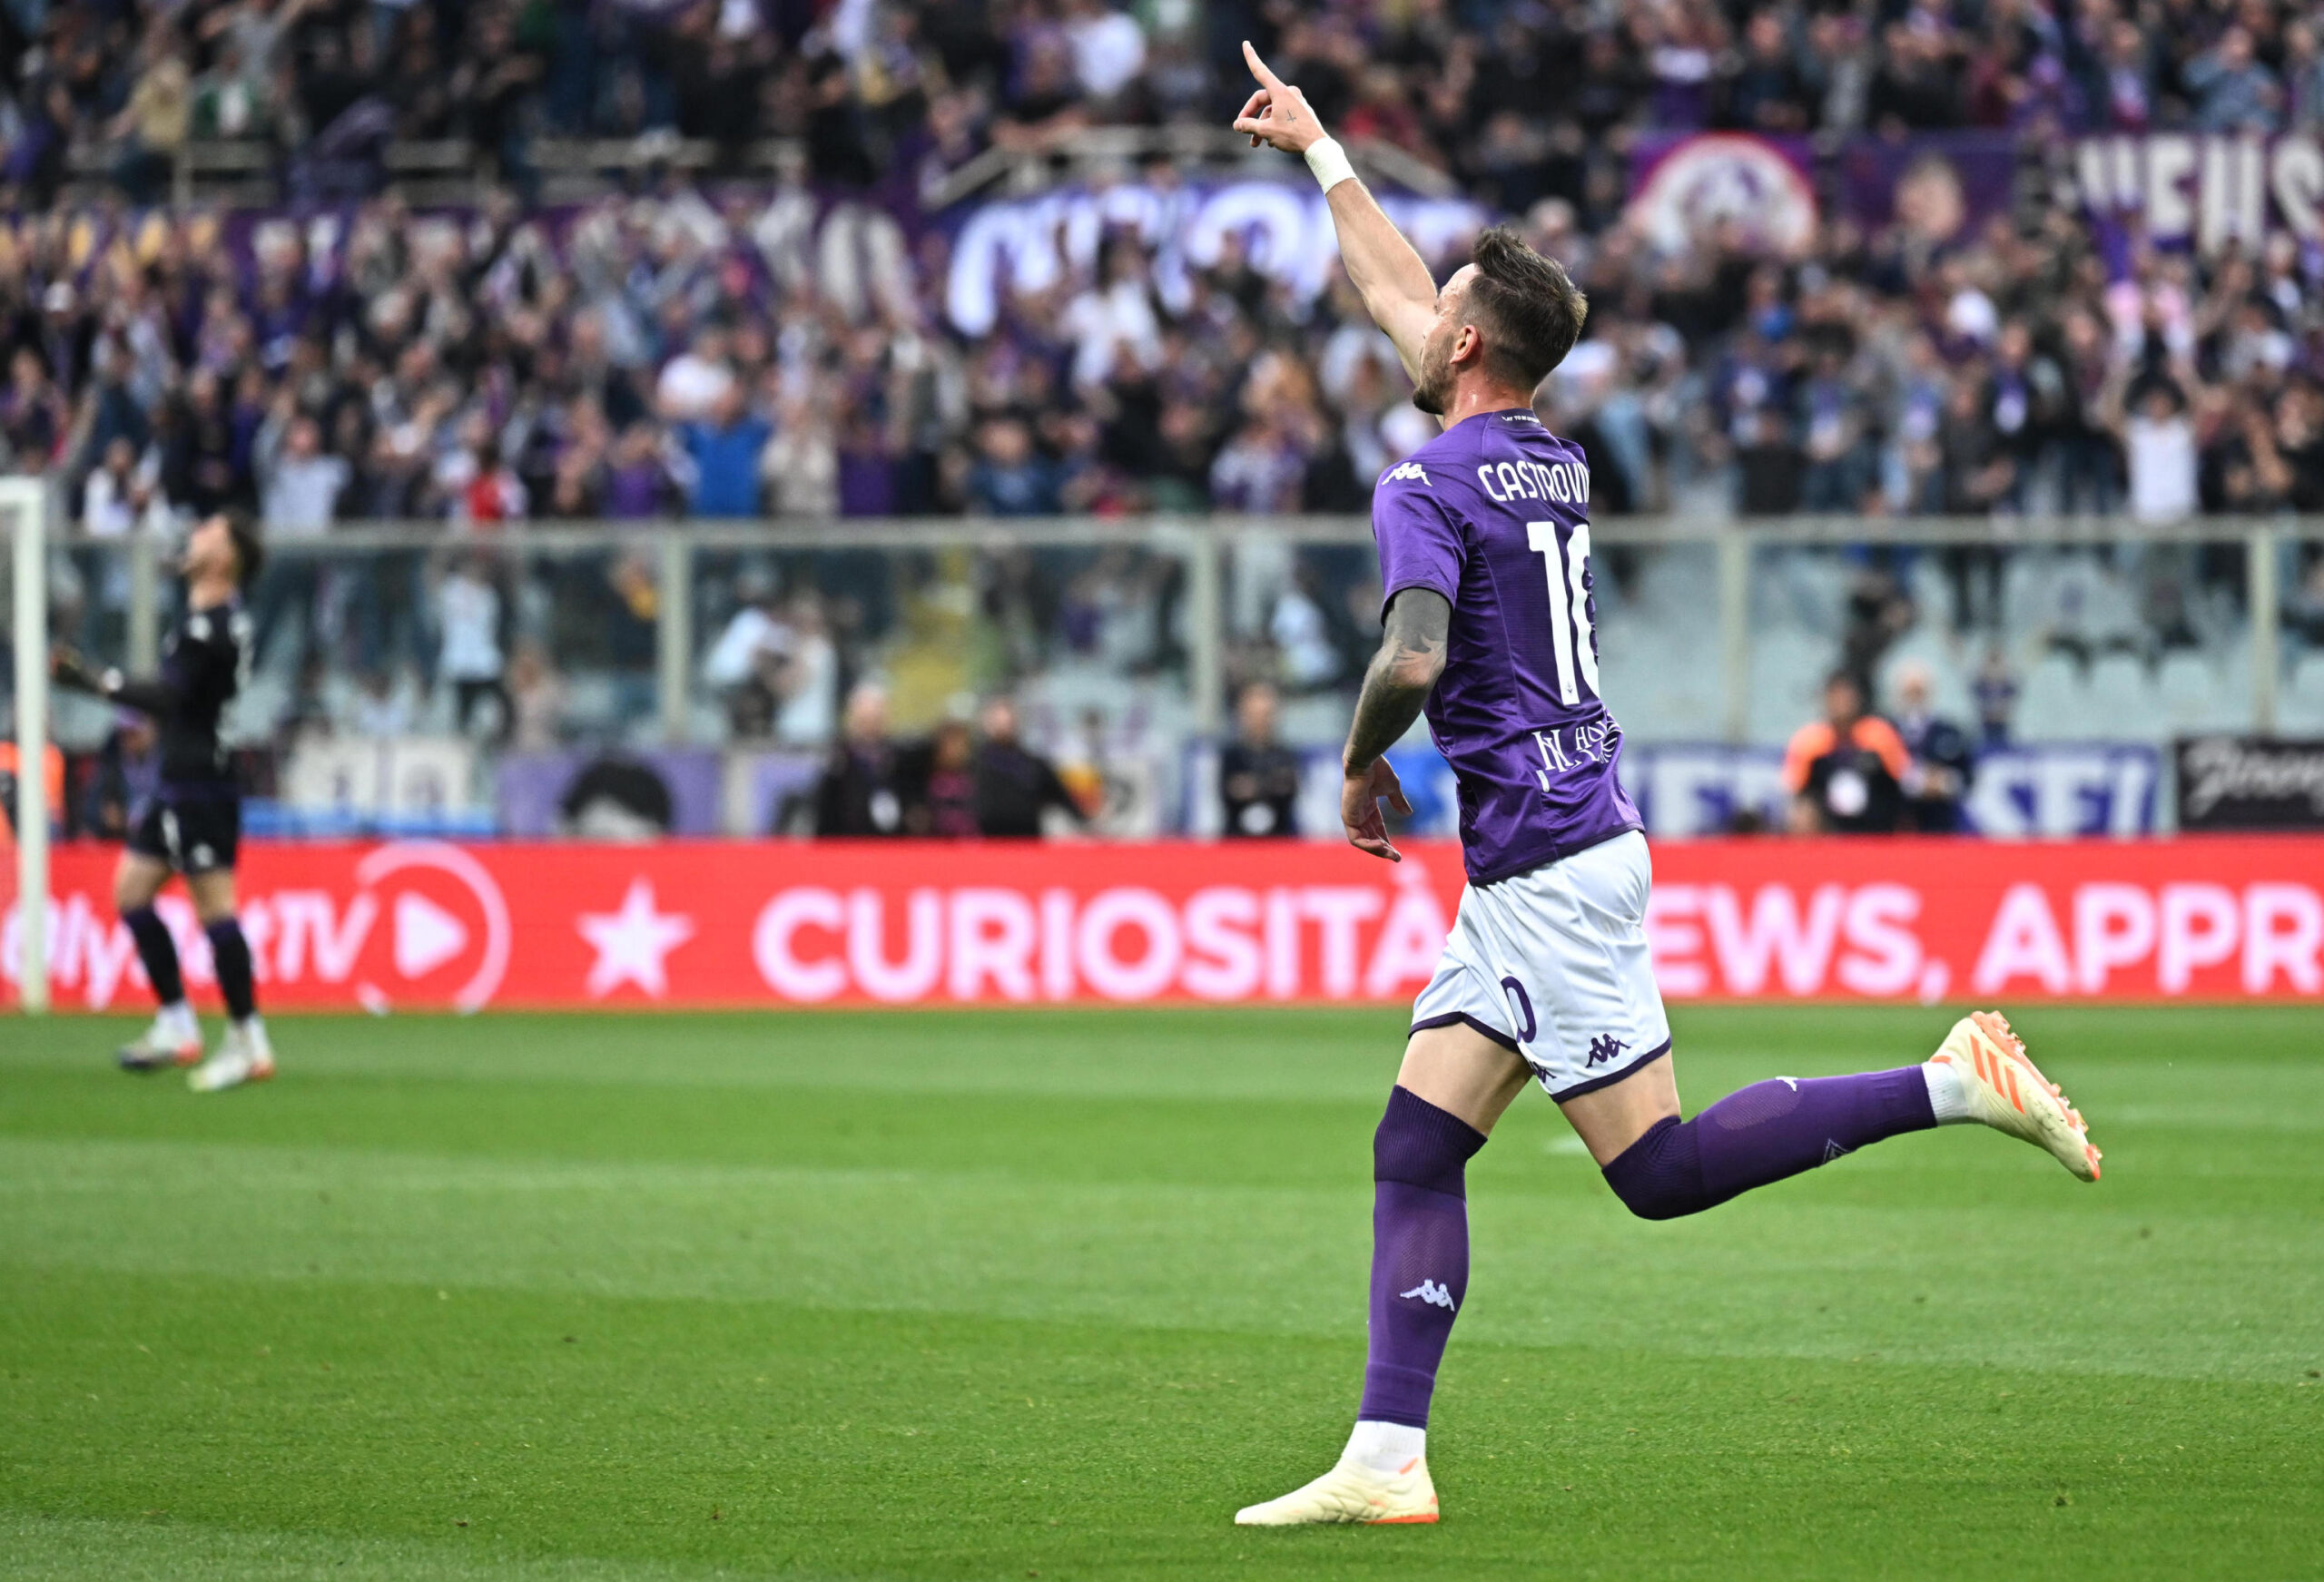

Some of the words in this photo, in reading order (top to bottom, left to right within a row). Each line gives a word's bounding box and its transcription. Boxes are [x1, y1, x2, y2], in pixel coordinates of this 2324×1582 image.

[1478, 460, 1590, 503] CASTROVI
[753, 856, 1452, 1002] CURIOSITÀ
[1645, 880, 1950, 1006] EWS,
[1971, 880, 2324, 996] APPR
